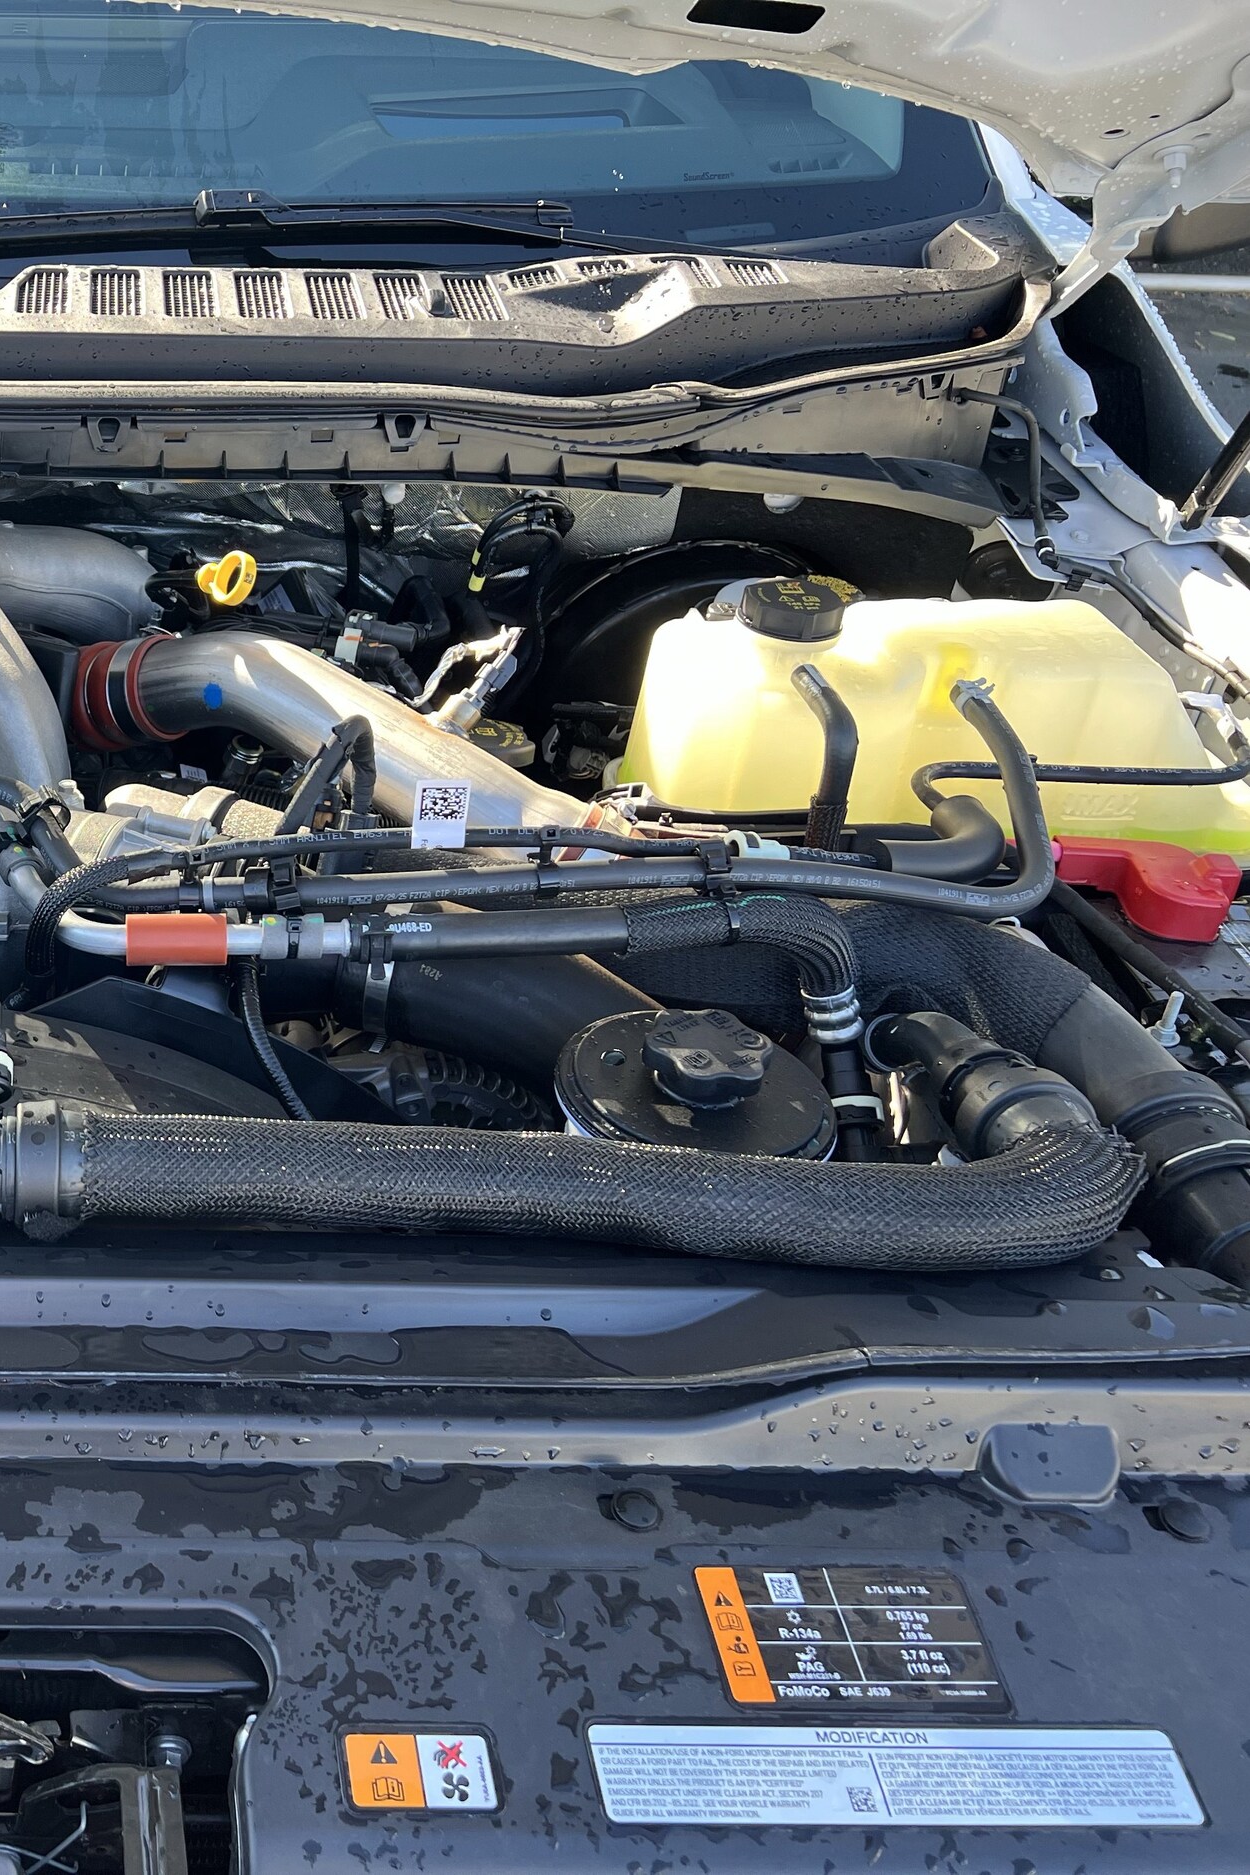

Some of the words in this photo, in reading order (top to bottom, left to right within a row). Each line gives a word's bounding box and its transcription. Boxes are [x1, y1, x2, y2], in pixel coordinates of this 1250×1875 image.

[297, 833, 346, 843] ARNITEL
[316, 897, 344, 905] 1041911
[435, 889, 450, 898] CIP
[886, 1610, 913, 1621] 0.765
[914, 1611, 929, 1623] kg
[899, 1622, 910, 1630] 27
[912, 1623, 924, 1631] oz
[778, 1627, 822, 1639] R-134a
[900, 1649, 917, 1660] 3.7
[918, 1650, 929, 1660] fl
[929, 1652, 945, 1661] oz
[797, 1661, 826, 1672] PAG
[907, 1662, 931, 1676] (110
[932, 1662, 951, 1676] cc)
[778, 1685, 830, 1697] FoMoCo
[839, 1686, 863, 1697] SAE
[867, 1687, 891, 1696] J639
[815, 1730, 929, 1744] MODIFICATION
